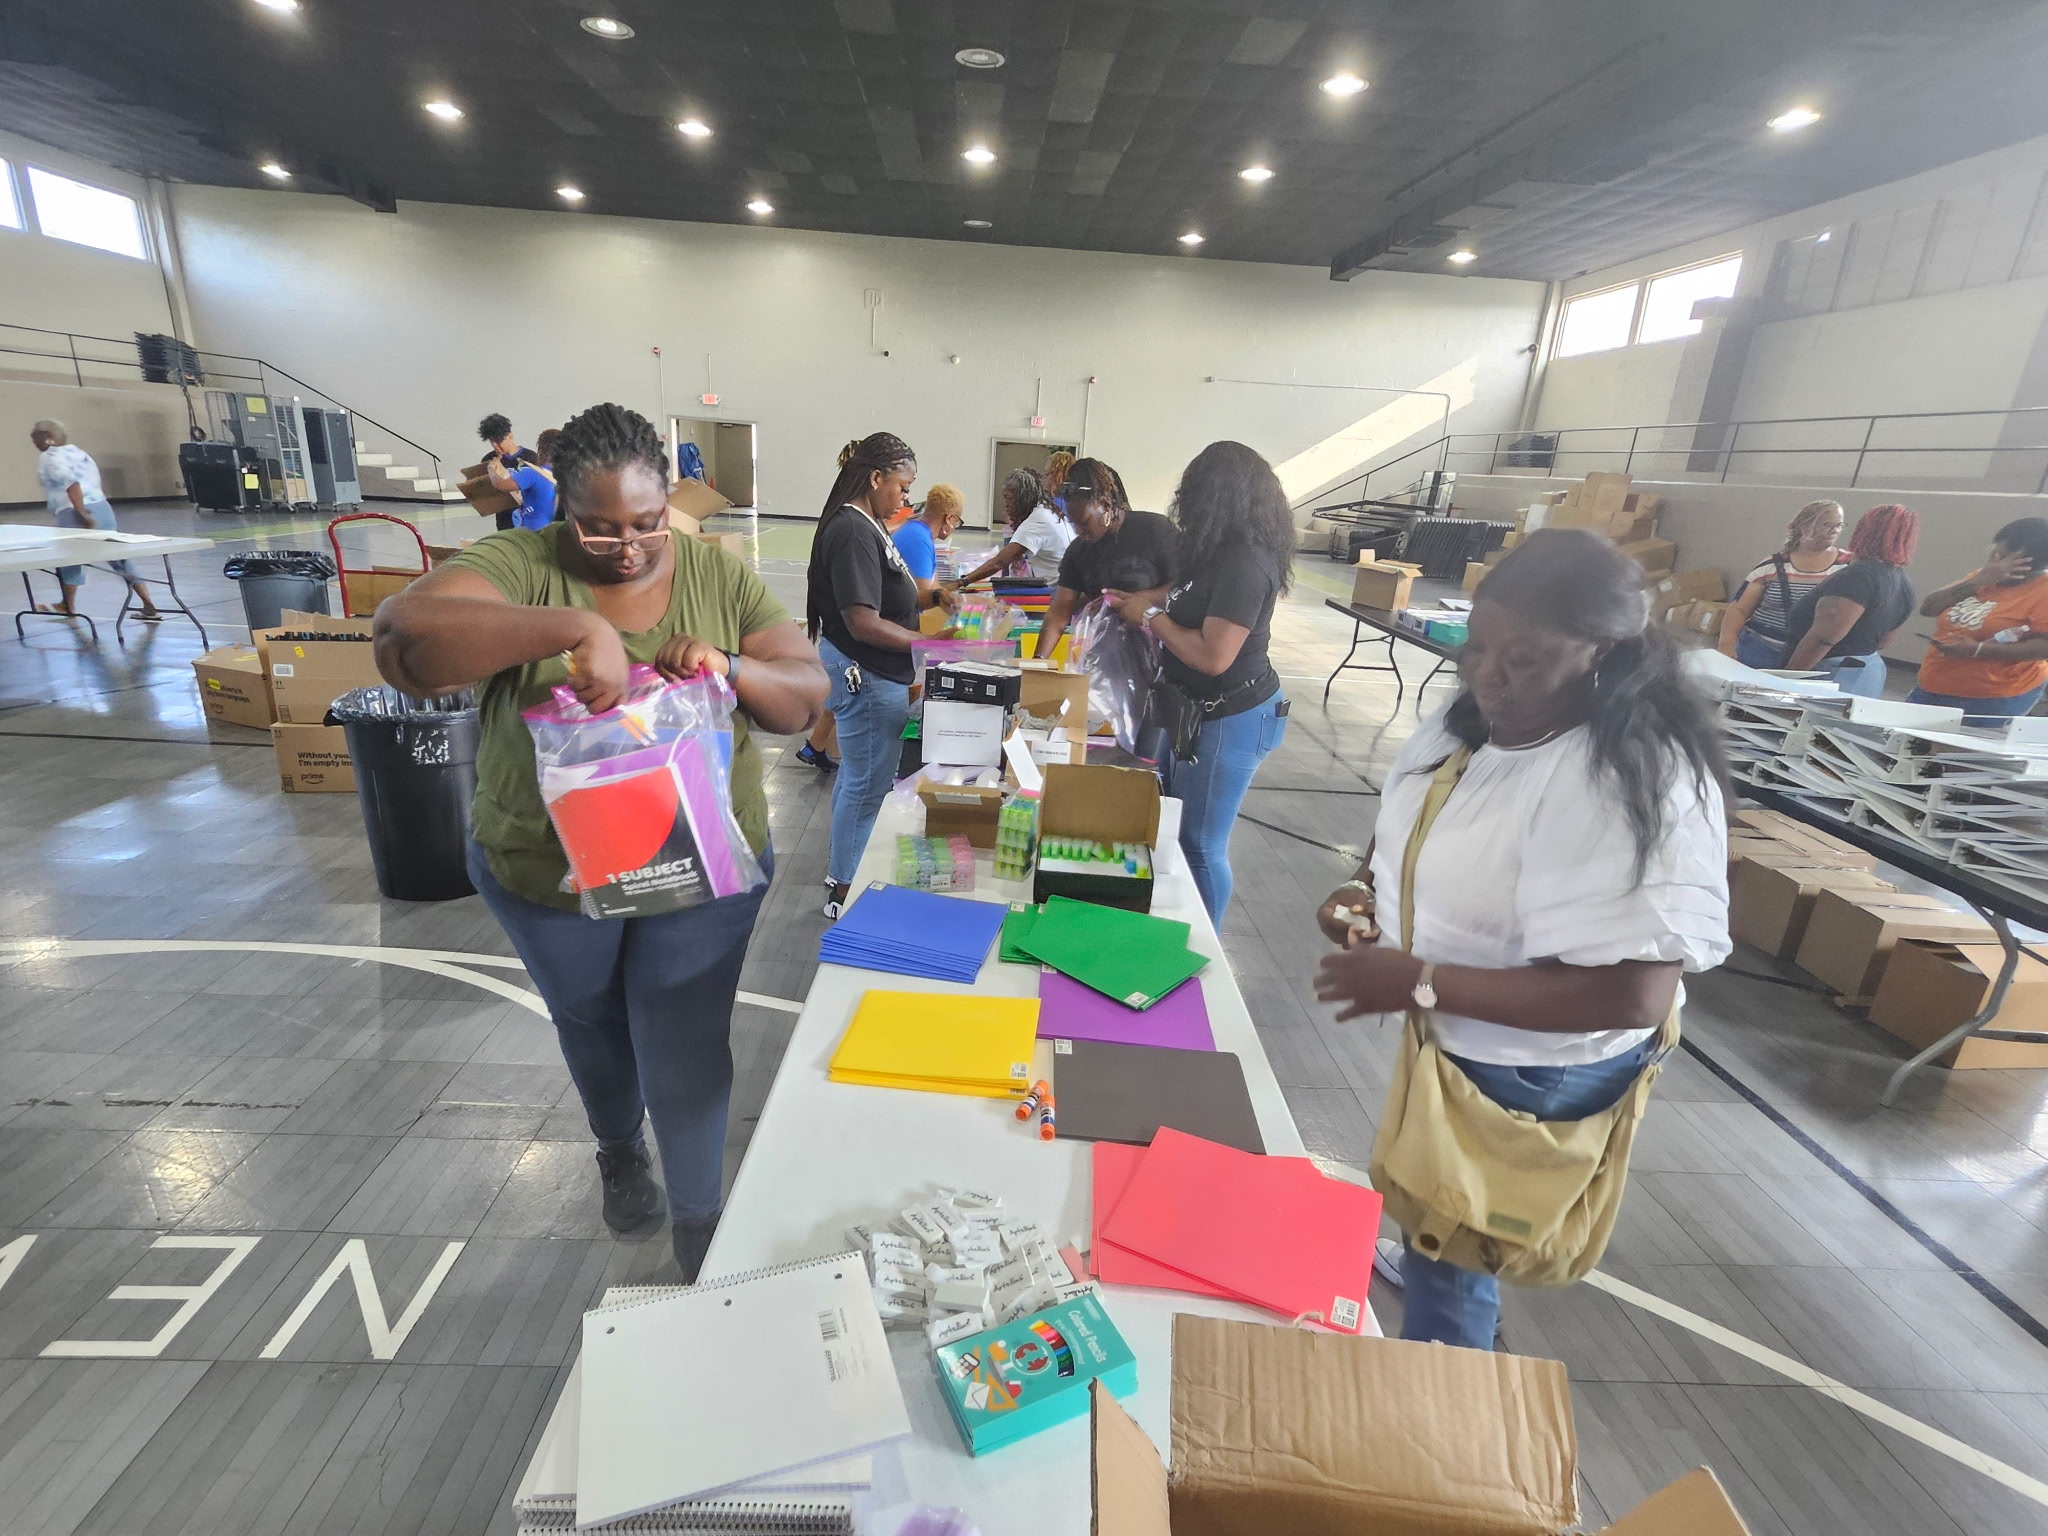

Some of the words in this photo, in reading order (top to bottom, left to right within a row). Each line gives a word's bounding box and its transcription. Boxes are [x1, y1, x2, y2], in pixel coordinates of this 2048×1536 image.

[313, 760, 340, 768] empty
[301, 772, 325, 780] prime
[606, 873, 618, 884] 1
[618, 857, 693, 883] SUBJECT
[1068, 1310, 1094, 1338] Colored
[1086, 1335, 1108, 1363] Pencils
